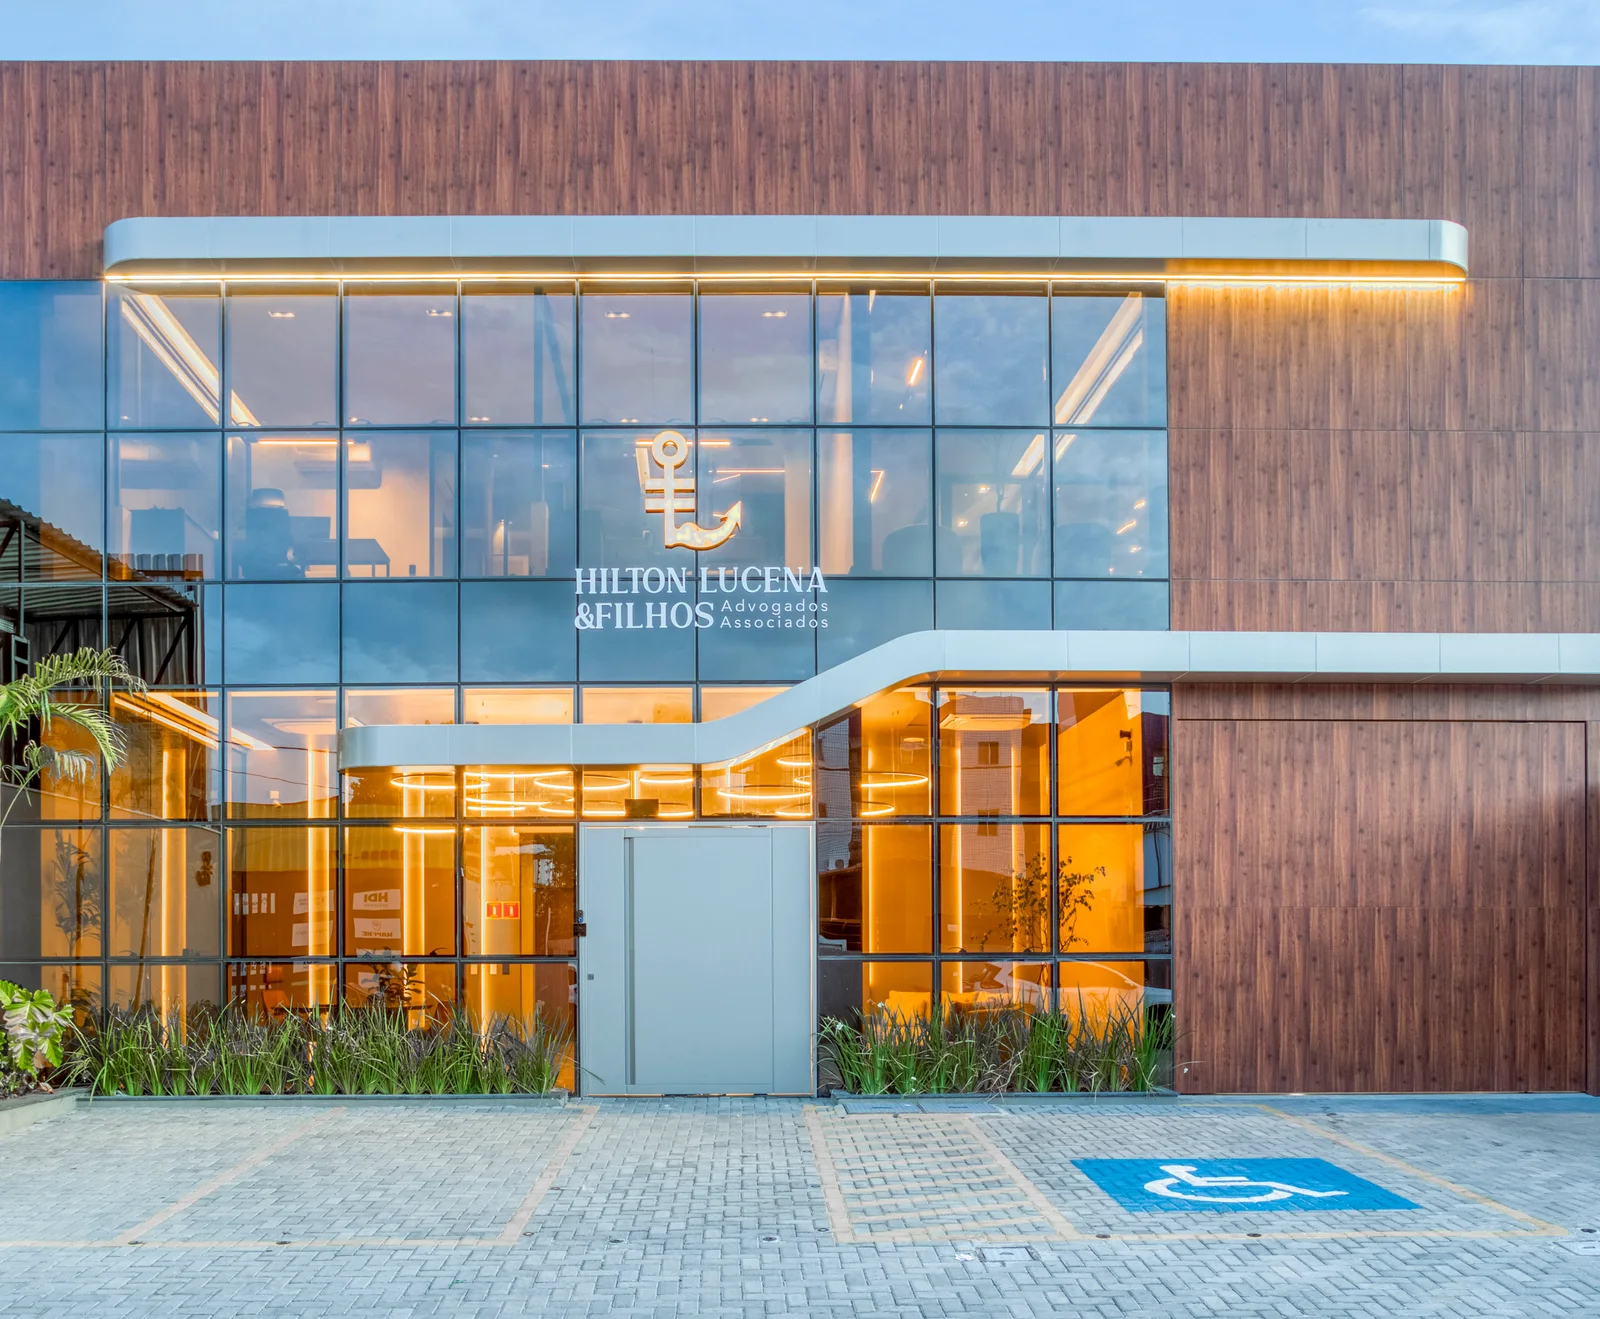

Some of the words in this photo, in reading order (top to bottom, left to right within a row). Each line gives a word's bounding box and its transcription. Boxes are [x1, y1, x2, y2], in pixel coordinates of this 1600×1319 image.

[574, 567, 687, 594] HILTON
[700, 566, 828, 593] LUCENA
[574, 601, 715, 630] &FILHOS
[721, 598, 828, 615] Advogados
[720, 615, 828, 628] Associados
